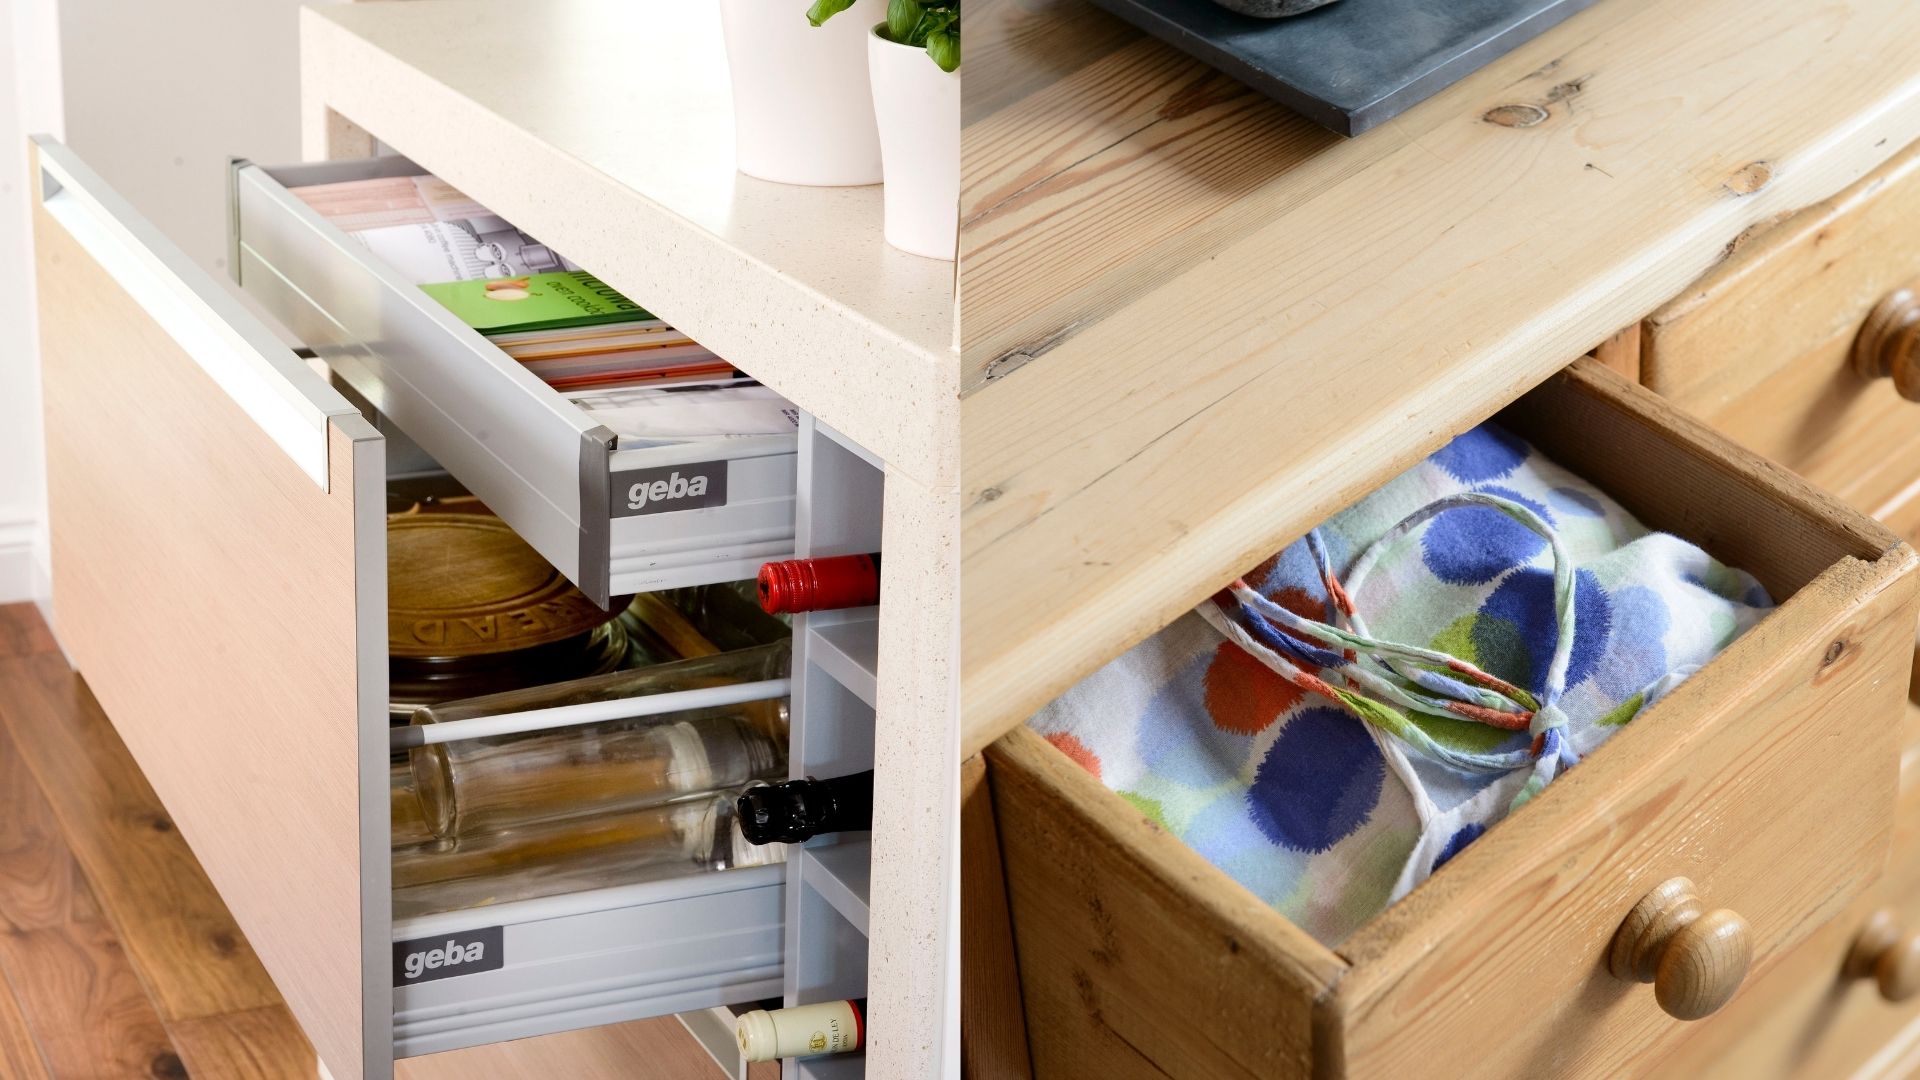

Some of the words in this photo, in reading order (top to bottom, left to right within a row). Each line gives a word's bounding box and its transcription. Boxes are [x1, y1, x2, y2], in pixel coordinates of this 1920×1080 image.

[546, 281, 575, 295] oven
[627, 471, 708, 510] geba
[404, 939, 484, 979] geba
[830, 1018, 839, 1032] LEY
